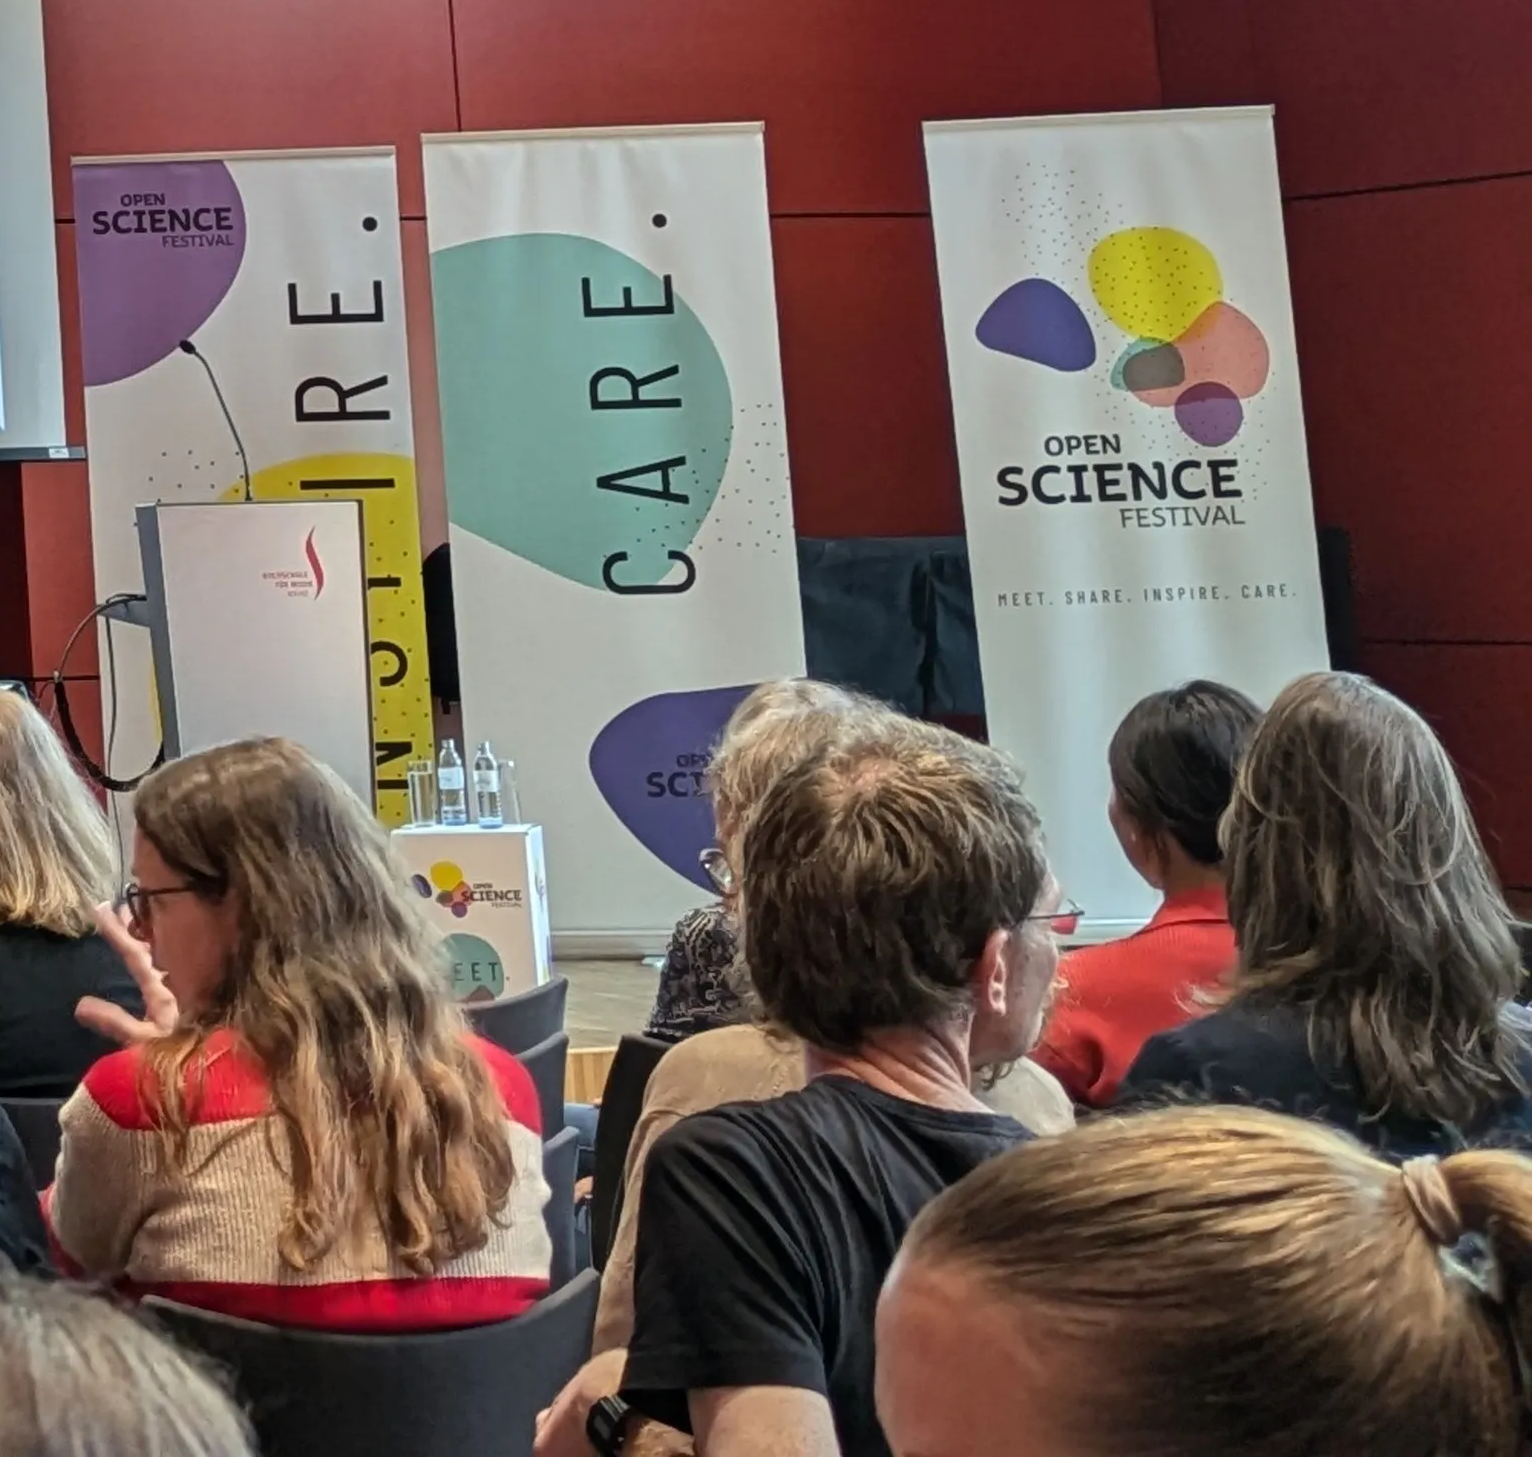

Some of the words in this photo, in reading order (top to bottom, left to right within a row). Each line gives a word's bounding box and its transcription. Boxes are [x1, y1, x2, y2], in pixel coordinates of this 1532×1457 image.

[120, 193, 166, 207] OPEN
[92, 207, 234, 235] SCIENCE
[161, 234, 235, 248] FESTIVAL
[581, 213, 698, 596] CARE.
[1044, 433, 1121, 456] OPEN
[996, 459, 1243, 506] SCIENCE
[1119, 505, 1246, 529] FESTIVAL
[997, 591, 1054, 607] MEET.
[1064, 588, 1132, 605] SHARE.
[1143, 585, 1231, 603] INSPIRE.
[1240, 583, 1297, 600] CARE.
[460, 889, 522, 903] SCIENCE
